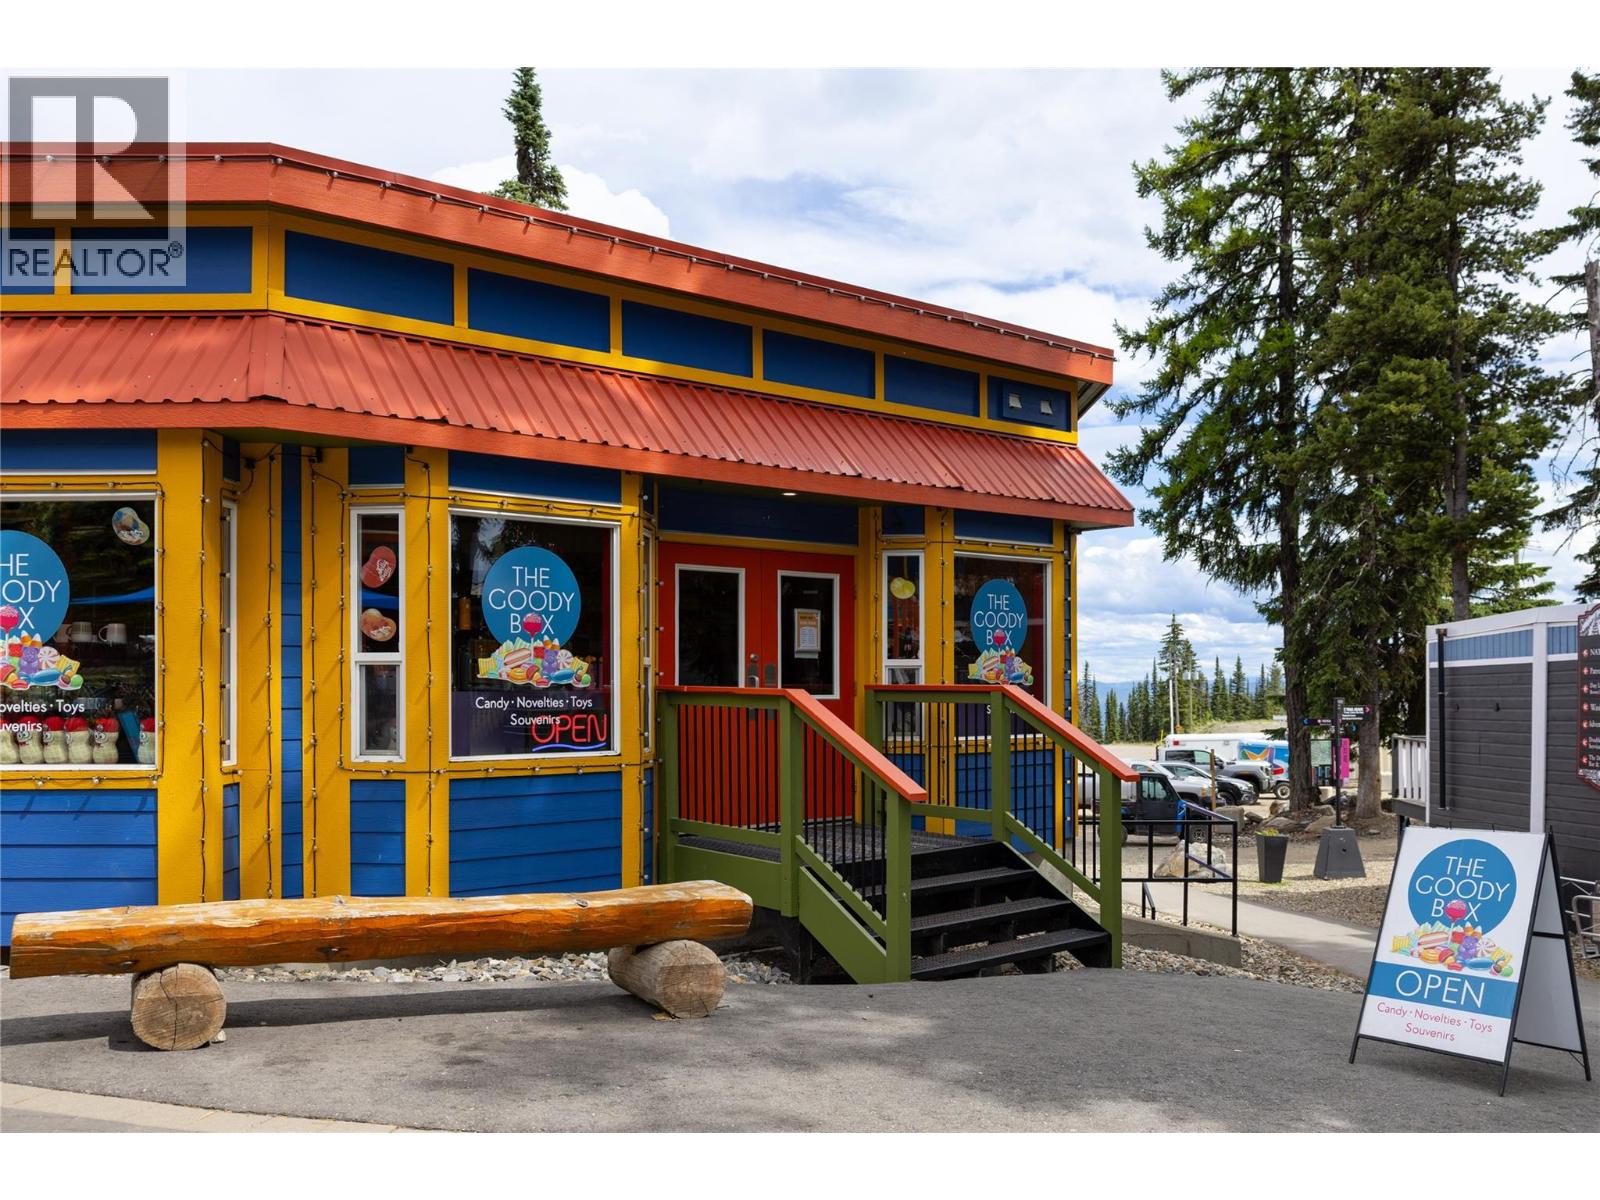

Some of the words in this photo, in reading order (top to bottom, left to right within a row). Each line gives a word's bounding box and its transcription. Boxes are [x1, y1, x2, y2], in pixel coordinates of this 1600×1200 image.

[0, 553, 29, 577] HE
[512, 566, 550, 588] THE
[2, 579, 61, 604] ODY
[488, 588, 575, 612] GOODY
[987, 594, 1010, 611] THE
[973, 611, 1025, 629] GOODY
[0, 699, 48, 713] ovelties
[55, 699, 85, 716] Toys
[475, 696, 510, 712] Candy
[516, 696, 564, 709] Novelties
[570, 695, 593, 709] Toys
[0, 720, 43, 732] uvenirs
[510, 713, 561, 726] Souvenirs
[531, 714, 607, 743] OPEN
[1445, 855, 1487, 878] THE
[1415, 875, 1511, 902] GOODY
[1395, 970, 1485, 1009] OPEN
[1377, 1002, 1408, 1018] Candy
[1414, 1009, 1462, 1027] Novelties
[1470, 1018, 1493, 1033] Toys
[1405, 1022, 1456, 1042] Souvenirs
